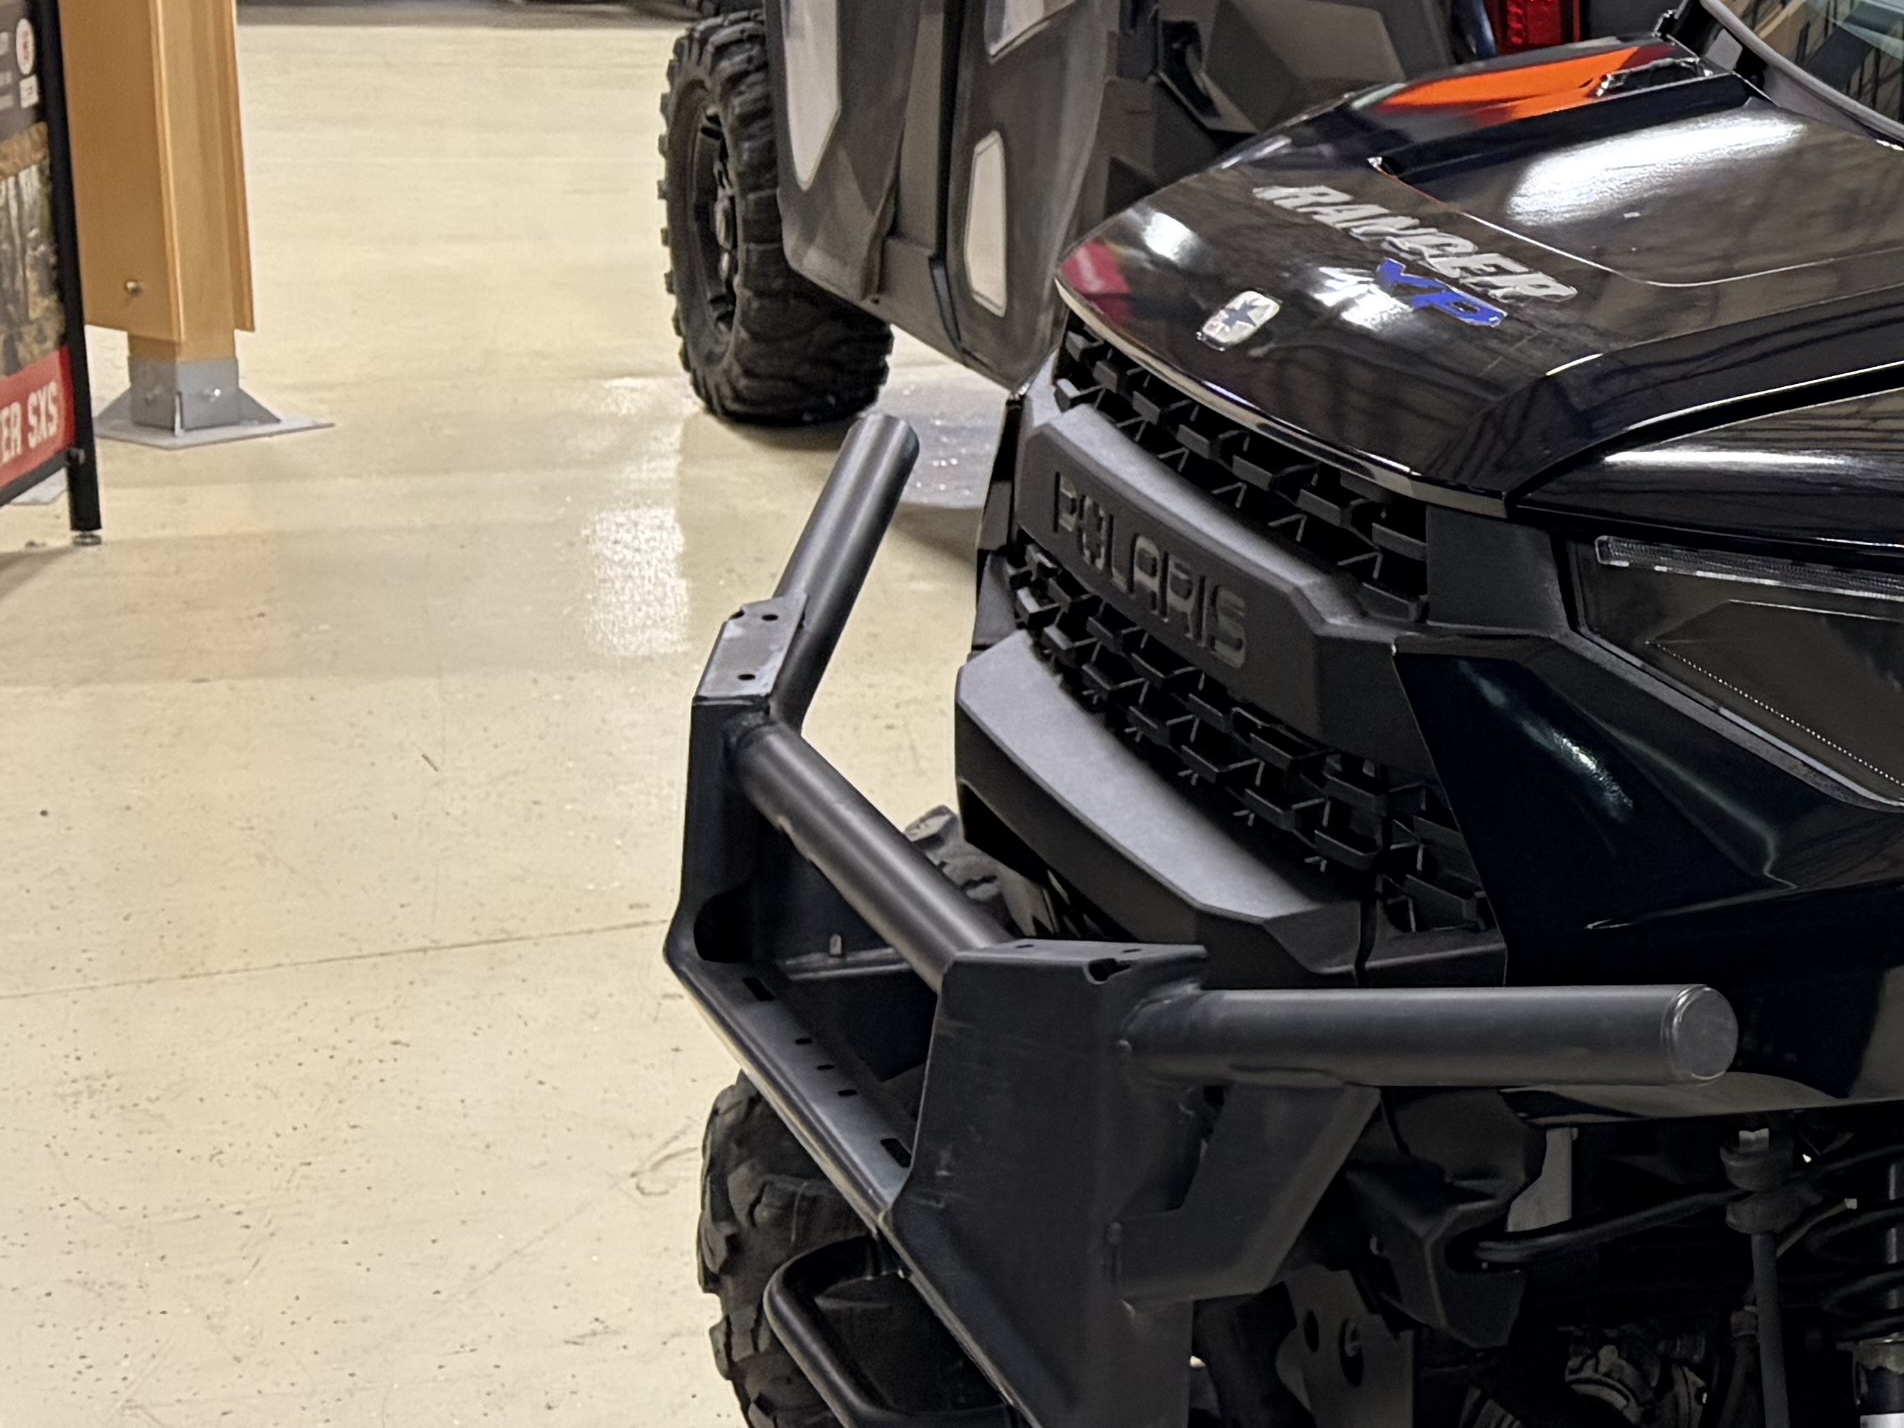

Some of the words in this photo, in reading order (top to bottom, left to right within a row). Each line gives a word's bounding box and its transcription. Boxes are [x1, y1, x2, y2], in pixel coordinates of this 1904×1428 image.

[1252, 184, 1578, 304] RANGER
[1377, 257, 1508, 328] XP
[1052, 471, 1247, 669] POLARIS
